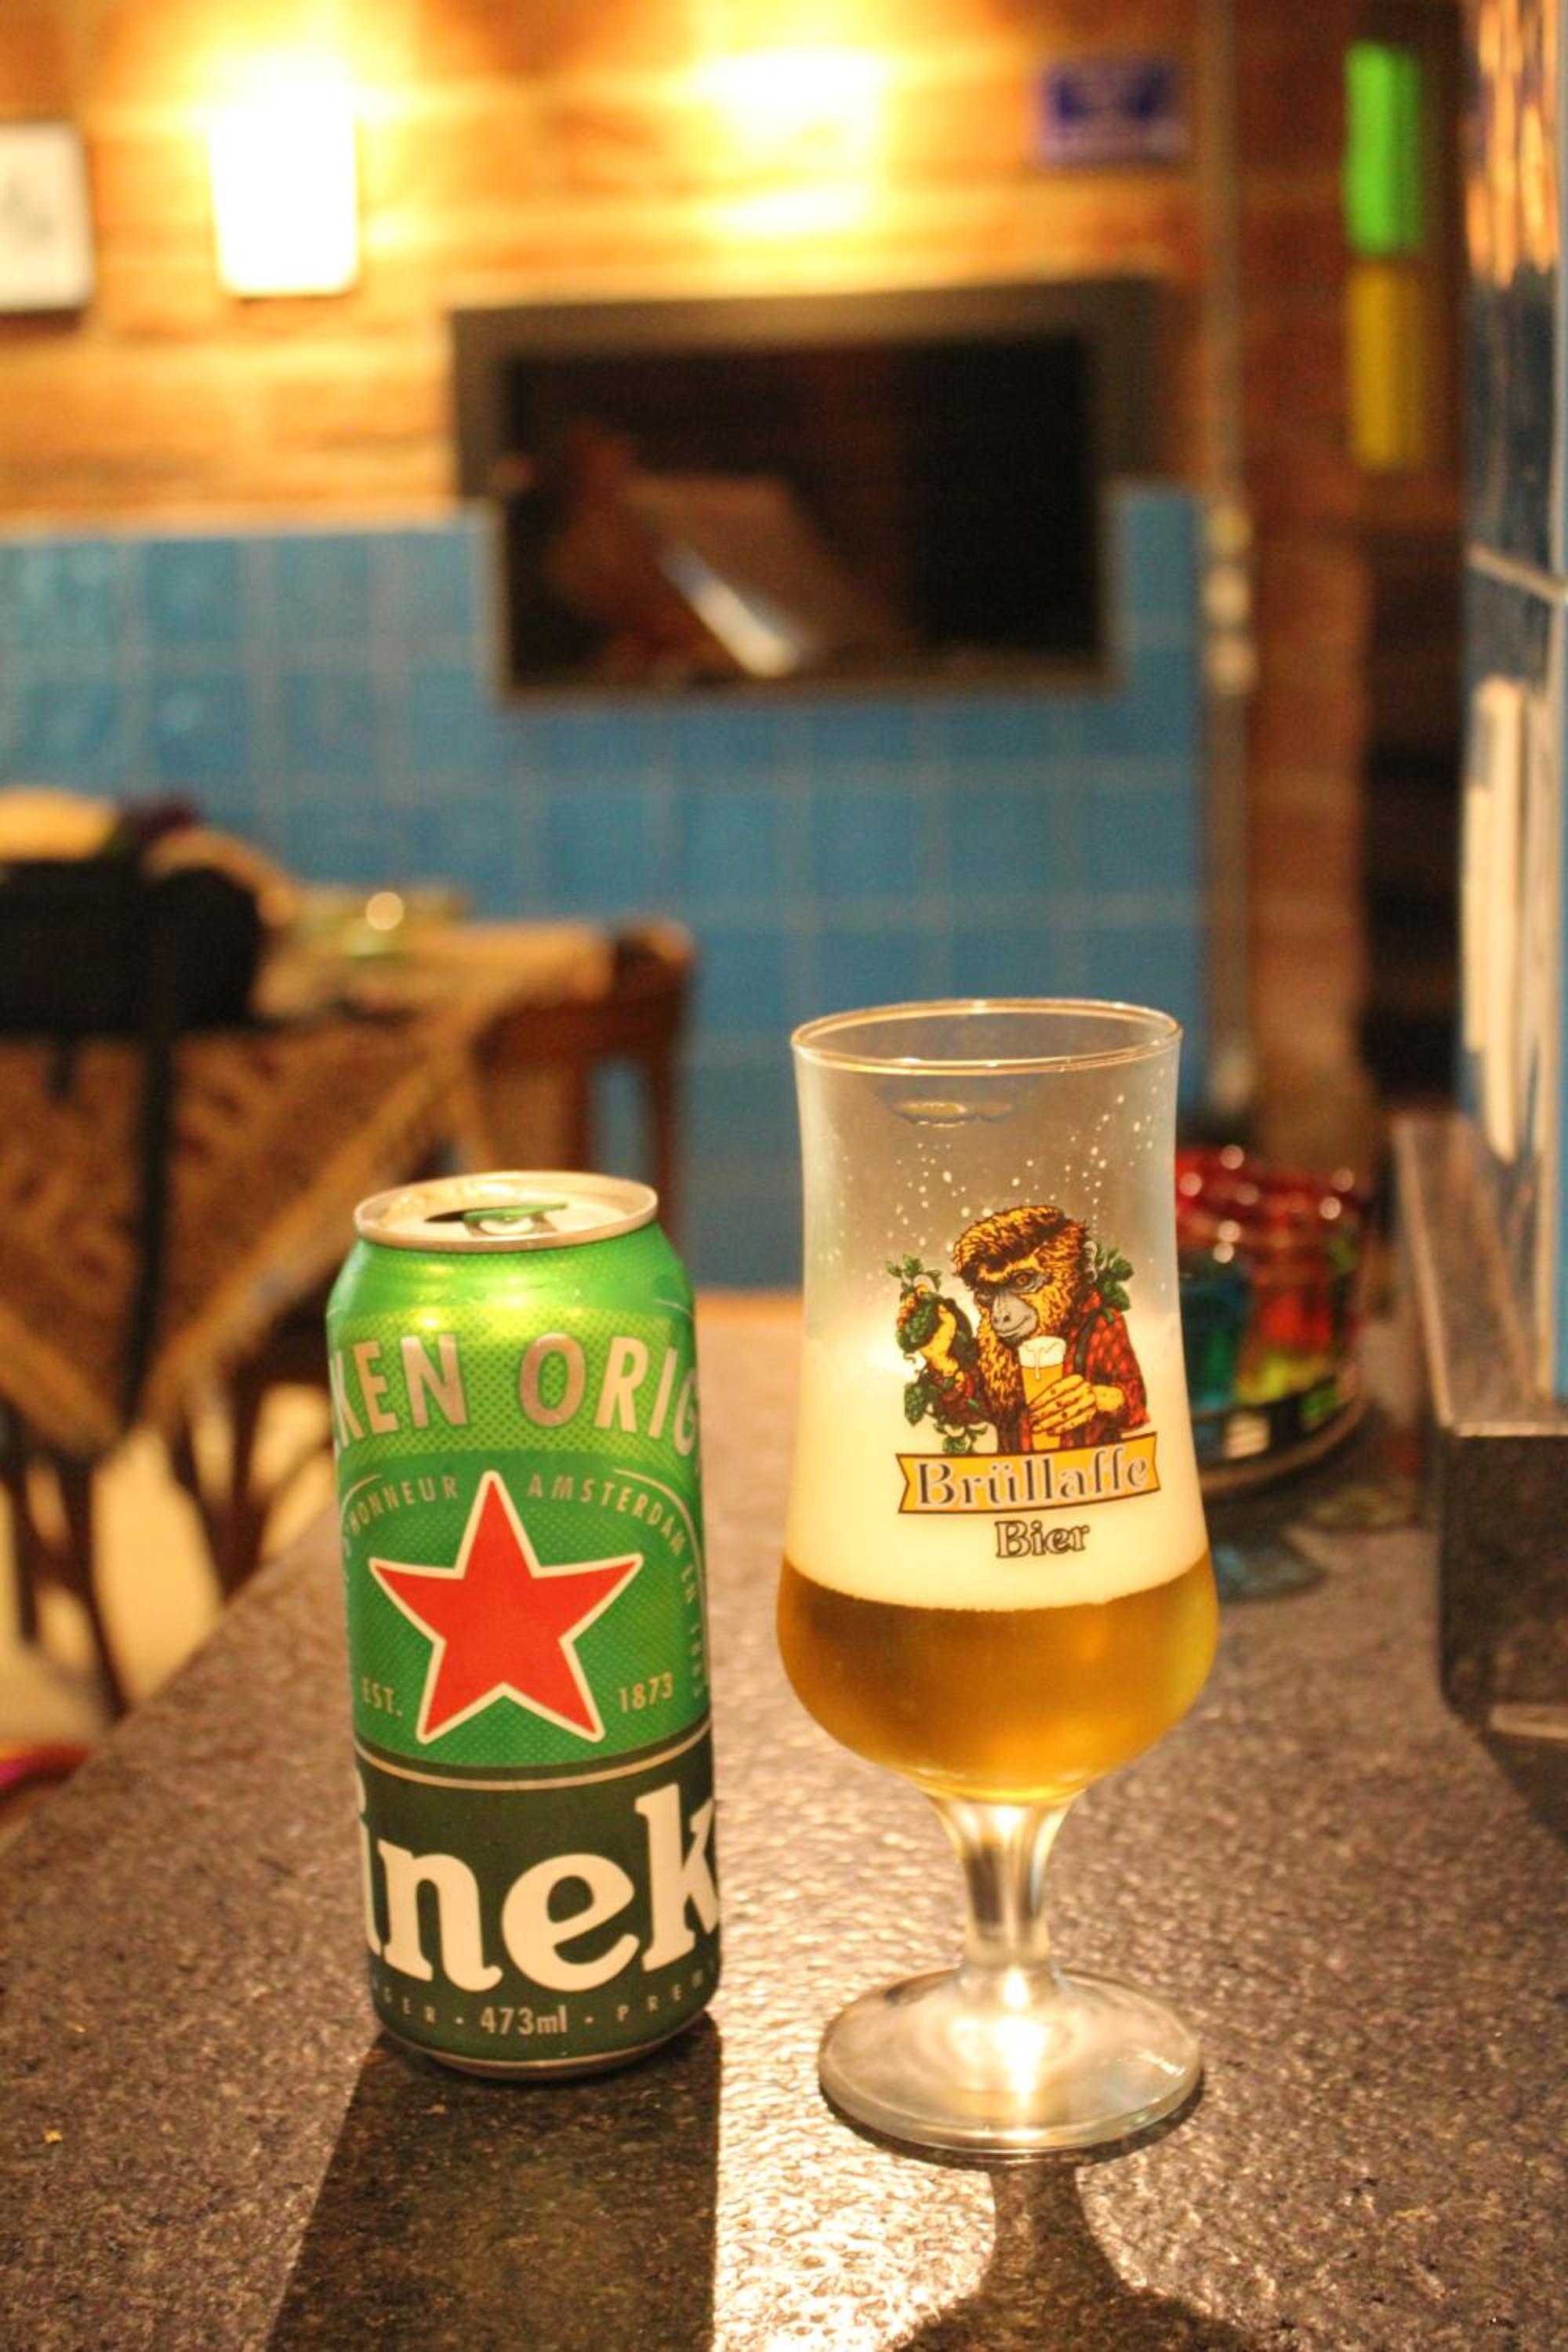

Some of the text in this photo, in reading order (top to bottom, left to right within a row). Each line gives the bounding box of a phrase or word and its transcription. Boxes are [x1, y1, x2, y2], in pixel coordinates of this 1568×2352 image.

[916, 1446, 1148, 1507] Brüllaffe
[994, 1519, 1091, 1559] Bier
[619, 1671, 674, 1713] 1873
[480, 2005, 567, 2034] 473ml
